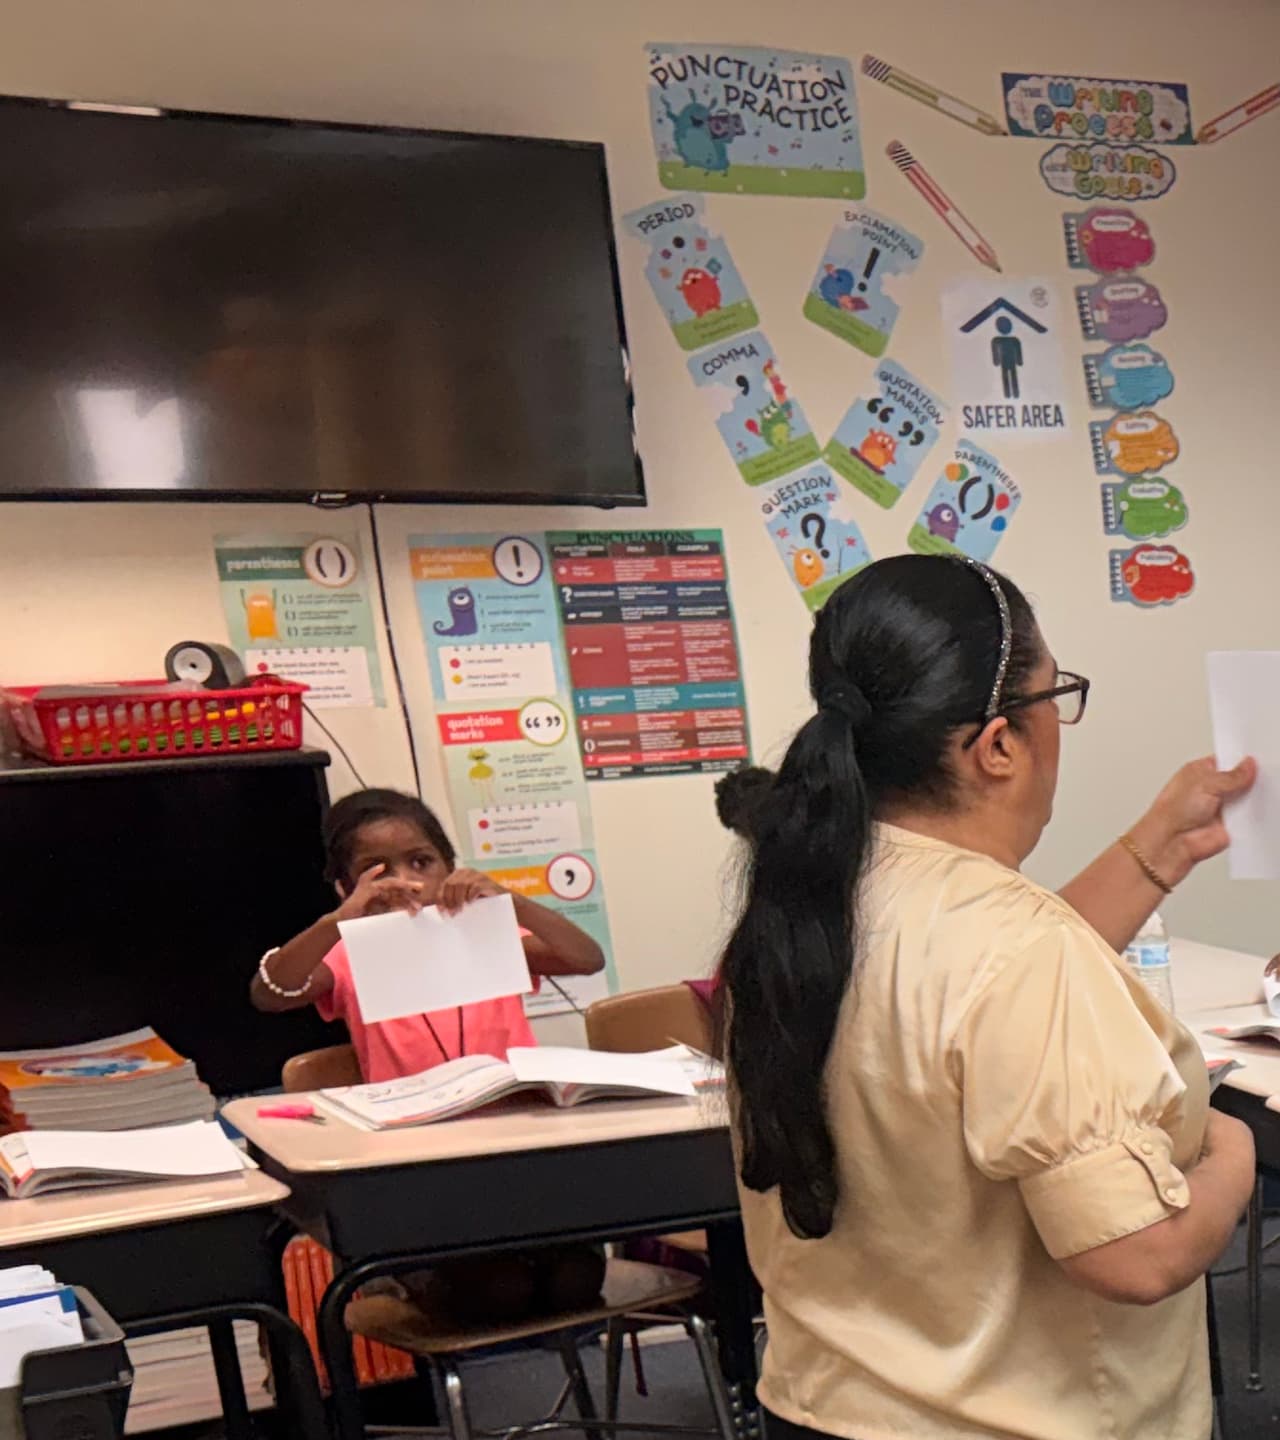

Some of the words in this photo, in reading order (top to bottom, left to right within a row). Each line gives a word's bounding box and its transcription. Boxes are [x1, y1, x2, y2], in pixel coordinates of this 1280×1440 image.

[650, 54, 846, 104] PUNCTUATION
[724, 84, 852, 132] PRACTICE
[637, 203, 695, 235] PERIOD
[844, 210, 918, 261] EXCLAMATION
[861, 228, 897, 253] POINT
[702, 343, 759, 376] COMMA
[878, 370, 944, 427] QUOTATION
[886, 386, 929, 426] MARKS
[962, 404, 1016, 429] SAFER
[1021, 404, 1065, 428] AREA
[953, 449, 1021, 500] PARENTHESES
[761, 475, 833, 515] QUESTION
[780, 492, 823, 520] MARK
[447, 714, 503, 730] quotation
[449, 728, 485, 740] marks
